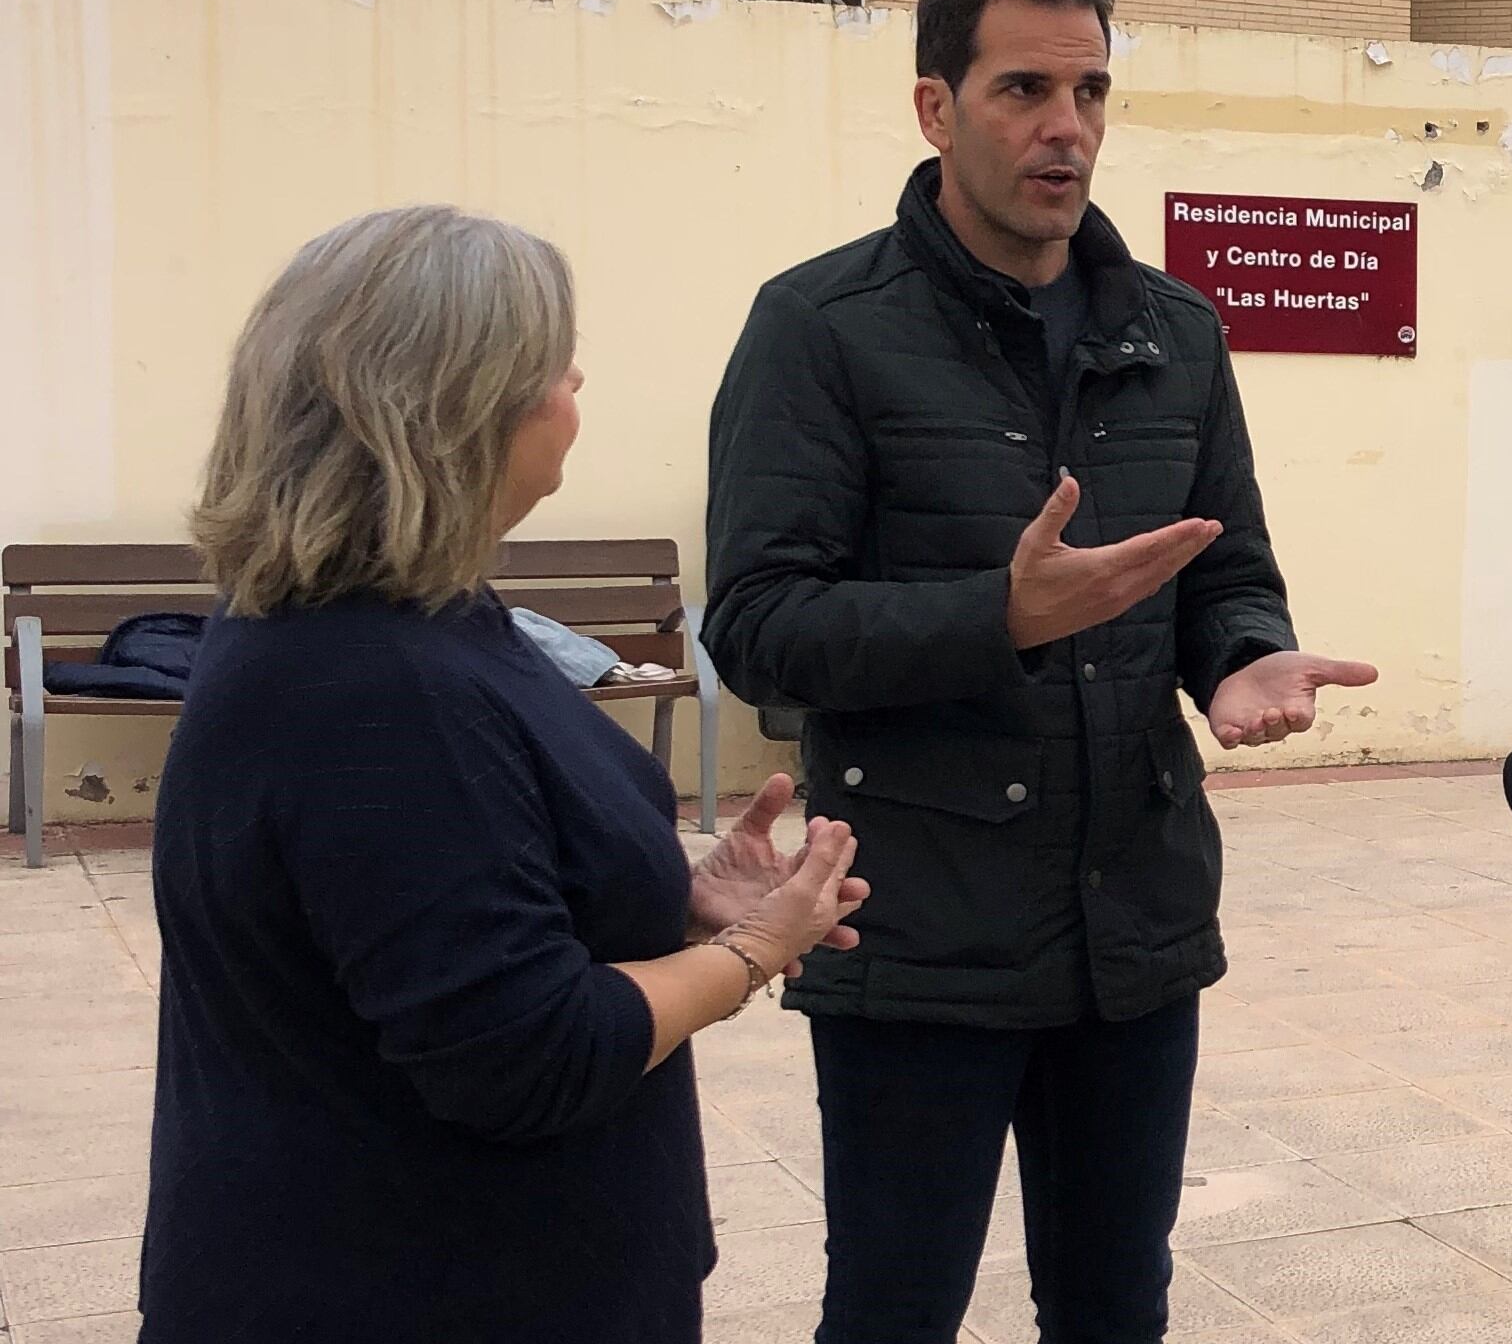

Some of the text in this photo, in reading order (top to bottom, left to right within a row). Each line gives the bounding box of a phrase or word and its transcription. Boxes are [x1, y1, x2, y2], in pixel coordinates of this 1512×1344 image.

[1174, 202, 1410, 233] Residencia Municipal
[1206, 246, 1378, 270] y Centro de Día
[1216, 287, 1369, 310] "Las Huertas"
